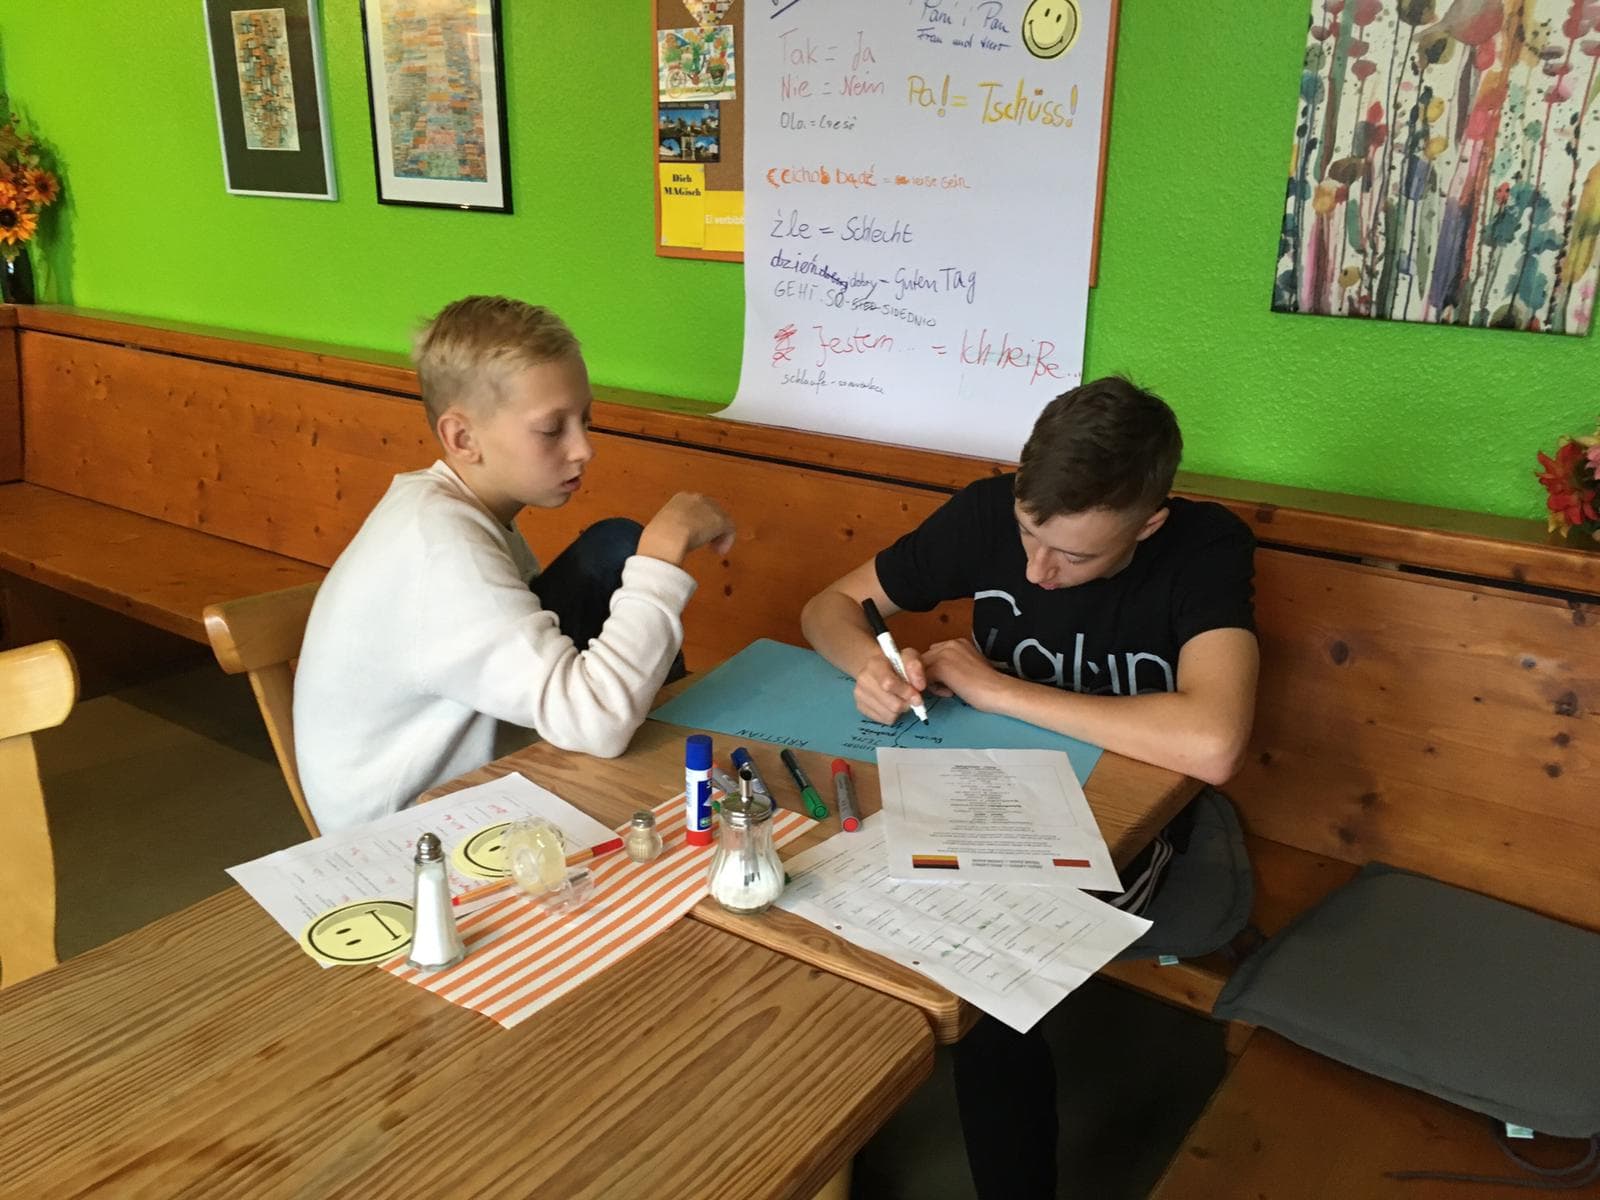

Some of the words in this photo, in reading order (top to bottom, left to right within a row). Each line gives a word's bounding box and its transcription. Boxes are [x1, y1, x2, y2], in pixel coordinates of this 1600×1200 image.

[778, 27, 818, 65] Tak
[851, 30, 876, 71] Ja
[781, 73, 813, 101] Nie
[839, 70, 885, 97] Nein
[907, 74, 950, 117] Pa!
[977, 76, 1079, 128] Tschüss!
[840, 214, 913, 244] Schlecht
[939, 267, 977, 304] Tag
